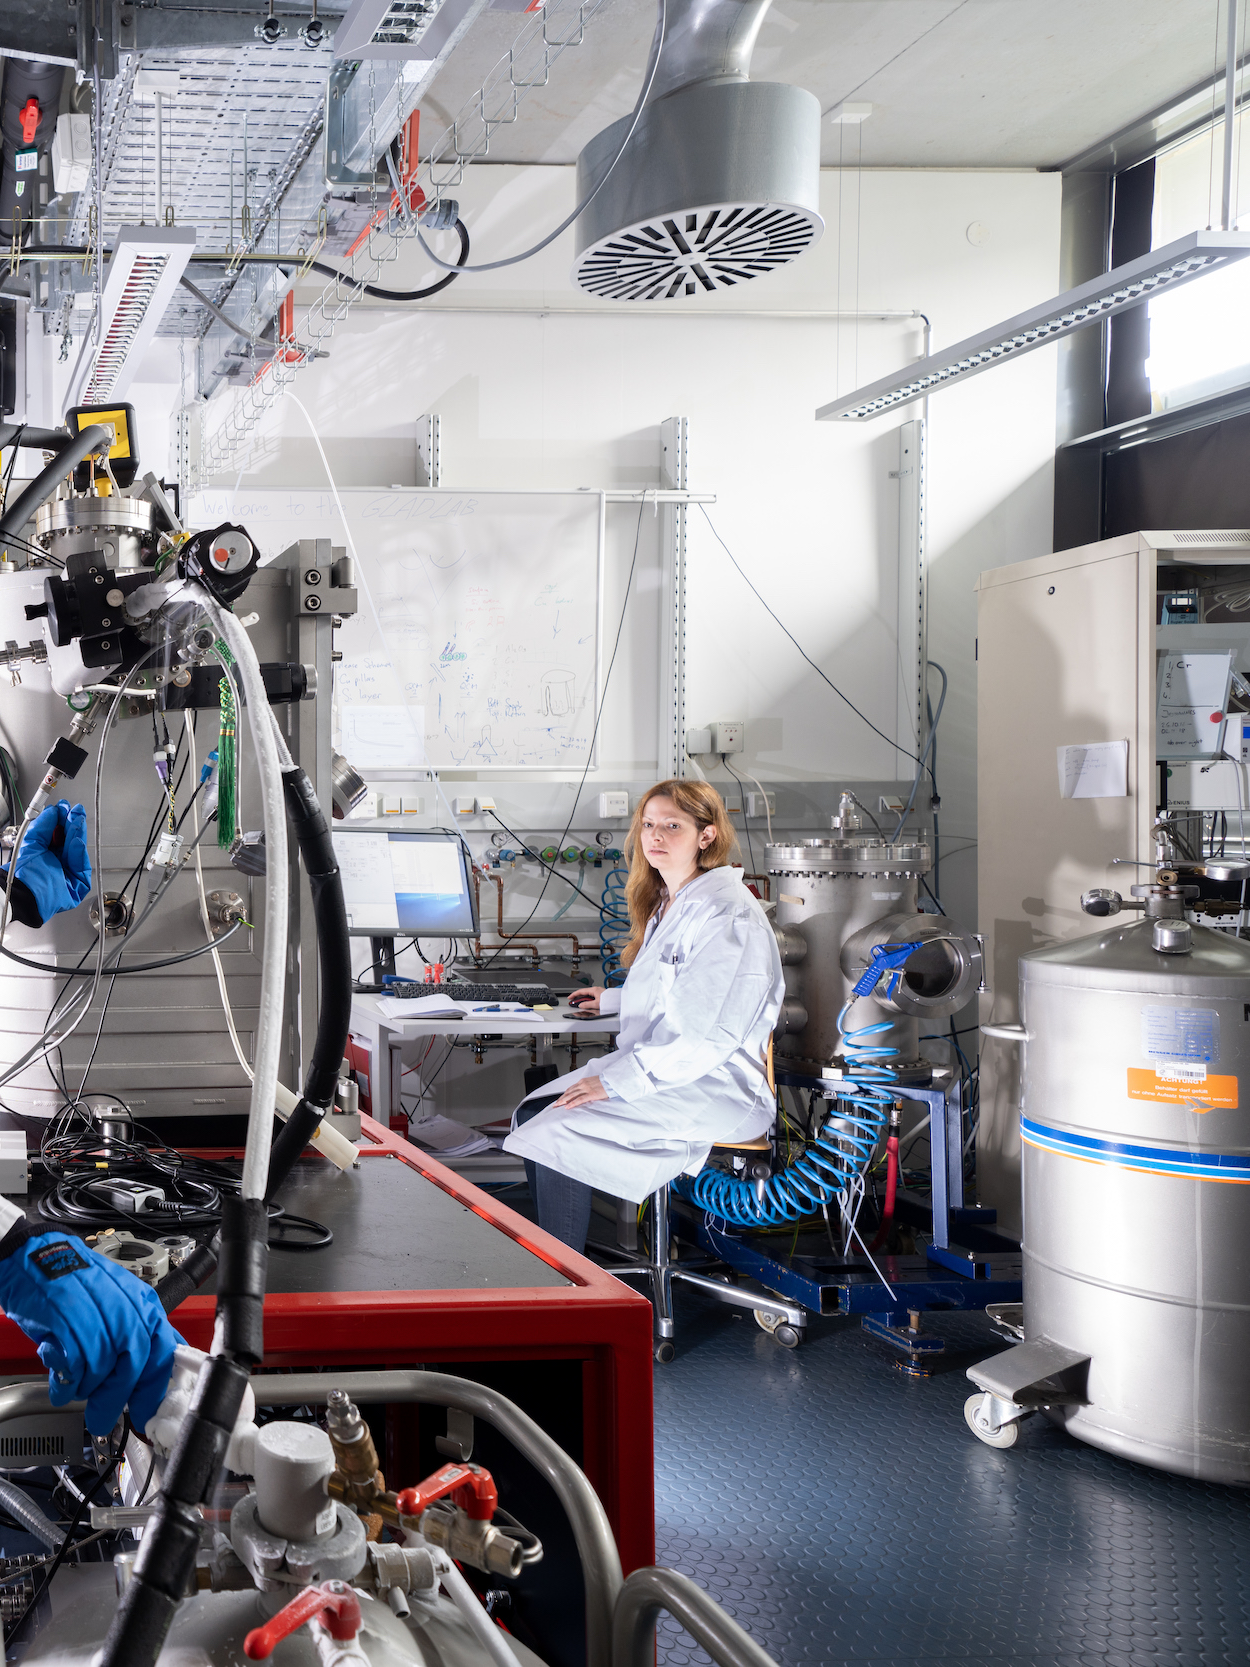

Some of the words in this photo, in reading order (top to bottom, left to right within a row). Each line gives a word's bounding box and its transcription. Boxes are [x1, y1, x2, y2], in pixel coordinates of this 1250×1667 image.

[201, 494, 272, 517] Welcome
[286, 495, 306, 517] to
[316, 496, 347, 517] the
[1176, 660, 1192, 669] Cr
[359, 688, 382, 703] layer
[1156, 1091, 1177, 1099] Aufsatz
